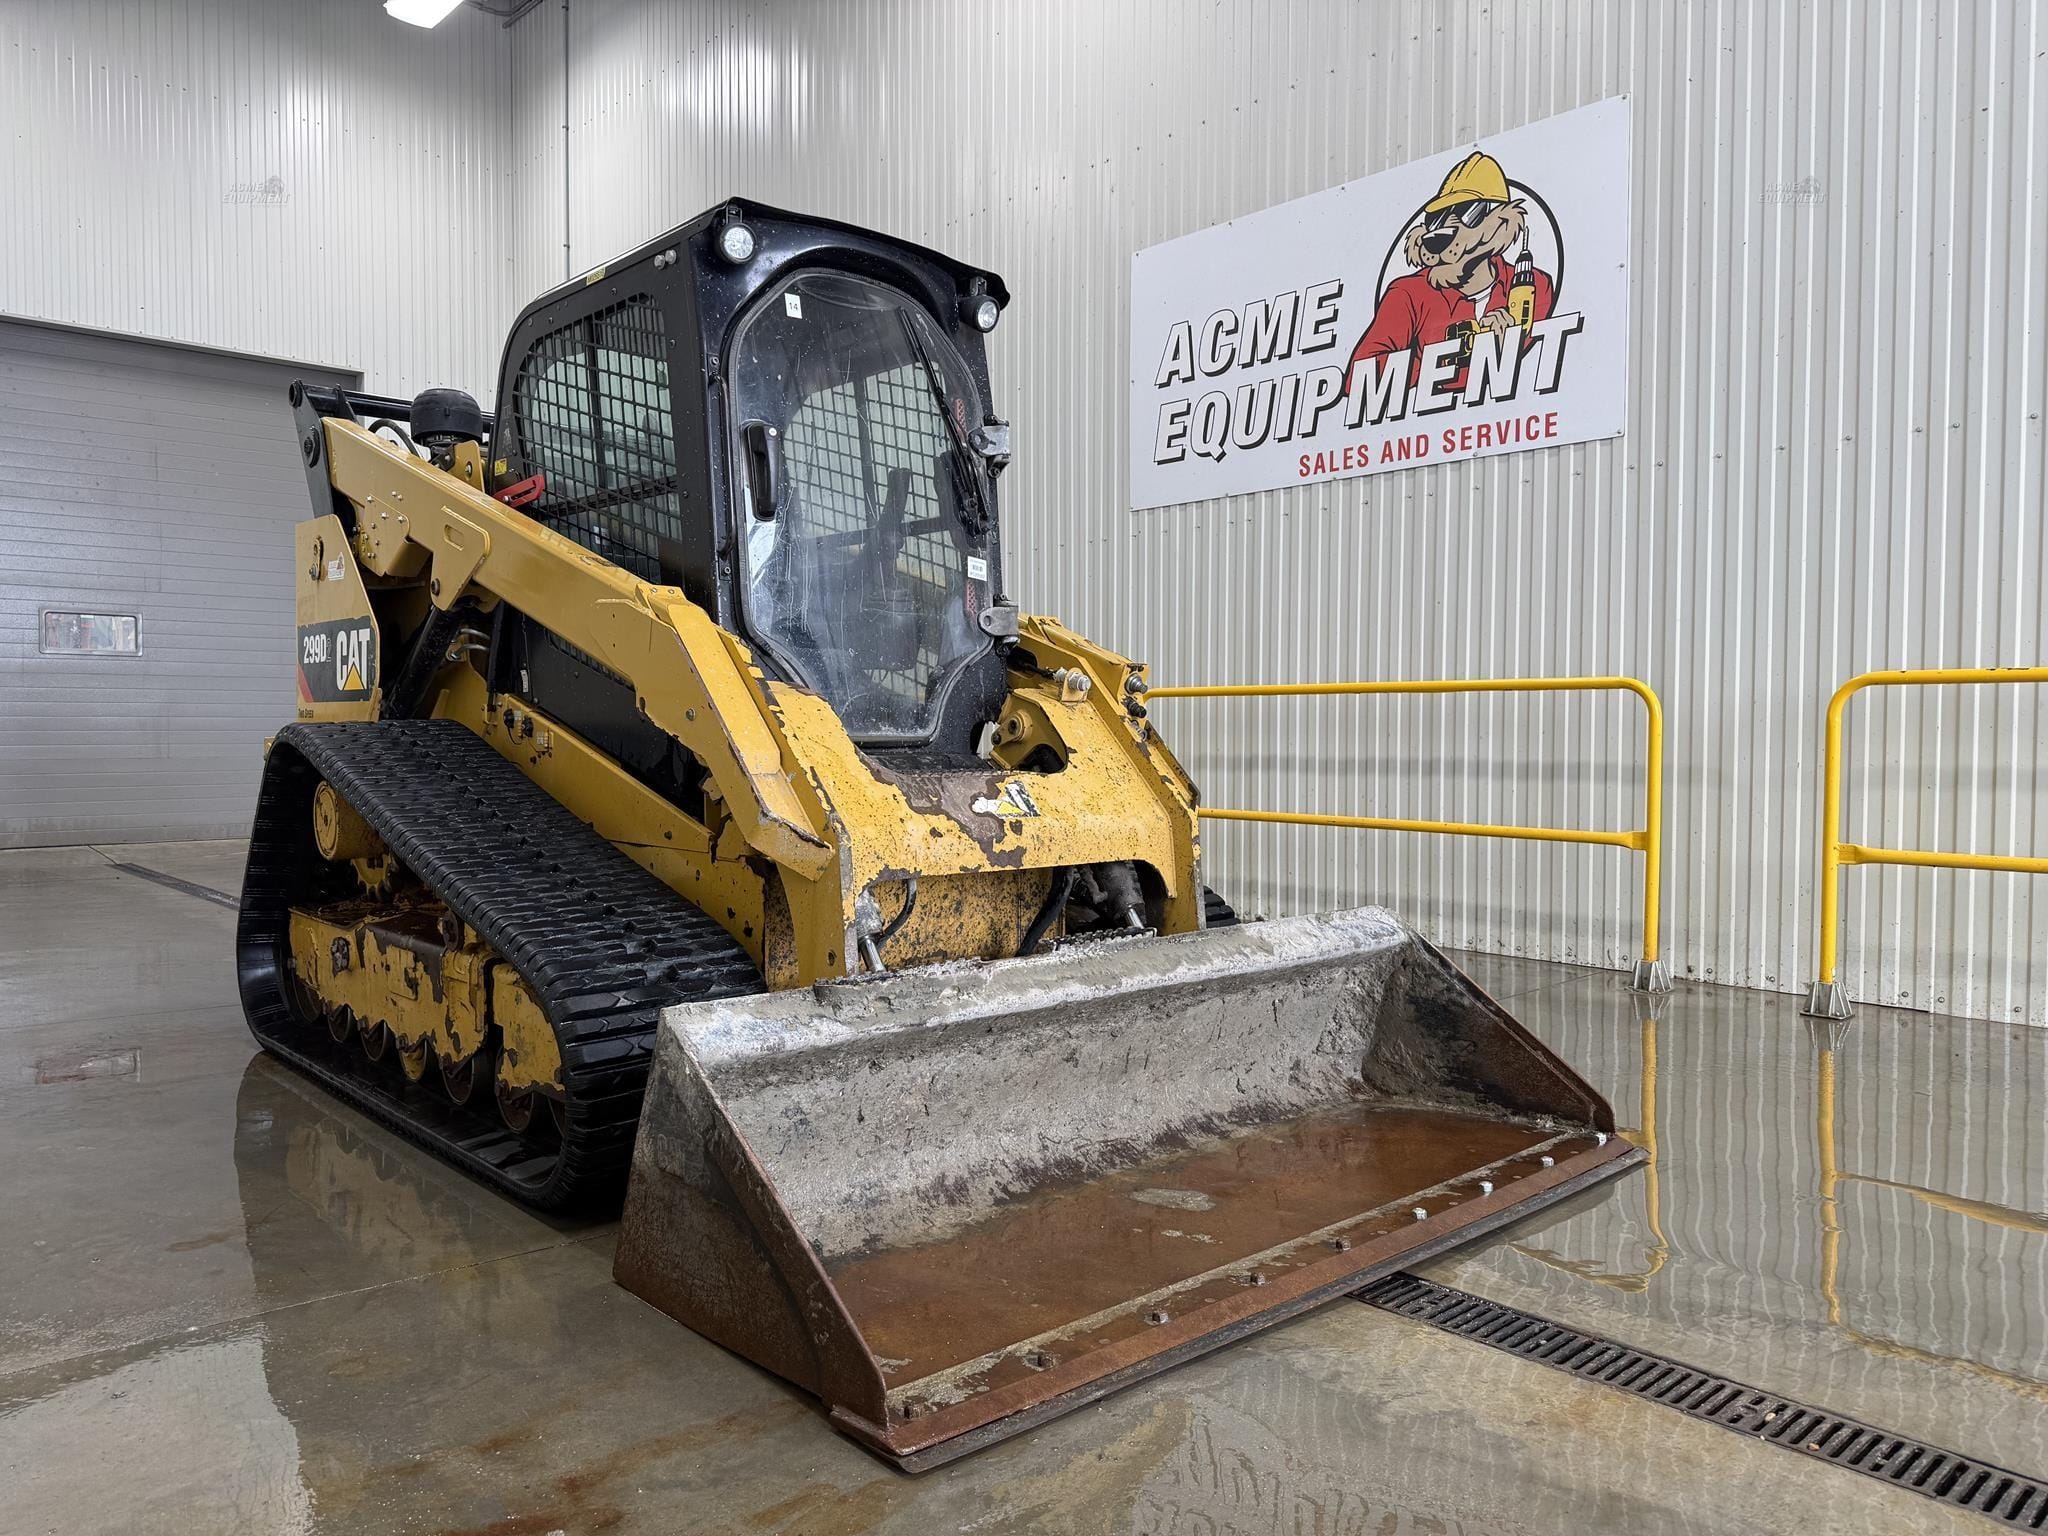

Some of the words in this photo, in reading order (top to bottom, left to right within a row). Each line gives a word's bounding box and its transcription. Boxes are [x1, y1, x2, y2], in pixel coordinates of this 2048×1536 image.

[1154, 278, 1343, 388] ACME
[1153, 311, 1585, 464] EQUIPMENT
[1299, 444, 1369, 478] SALES
[1380, 433, 1429, 463] AND
[1441, 411, 1559, 455] SERVICE
[336, 628, 371, 691] CAT
